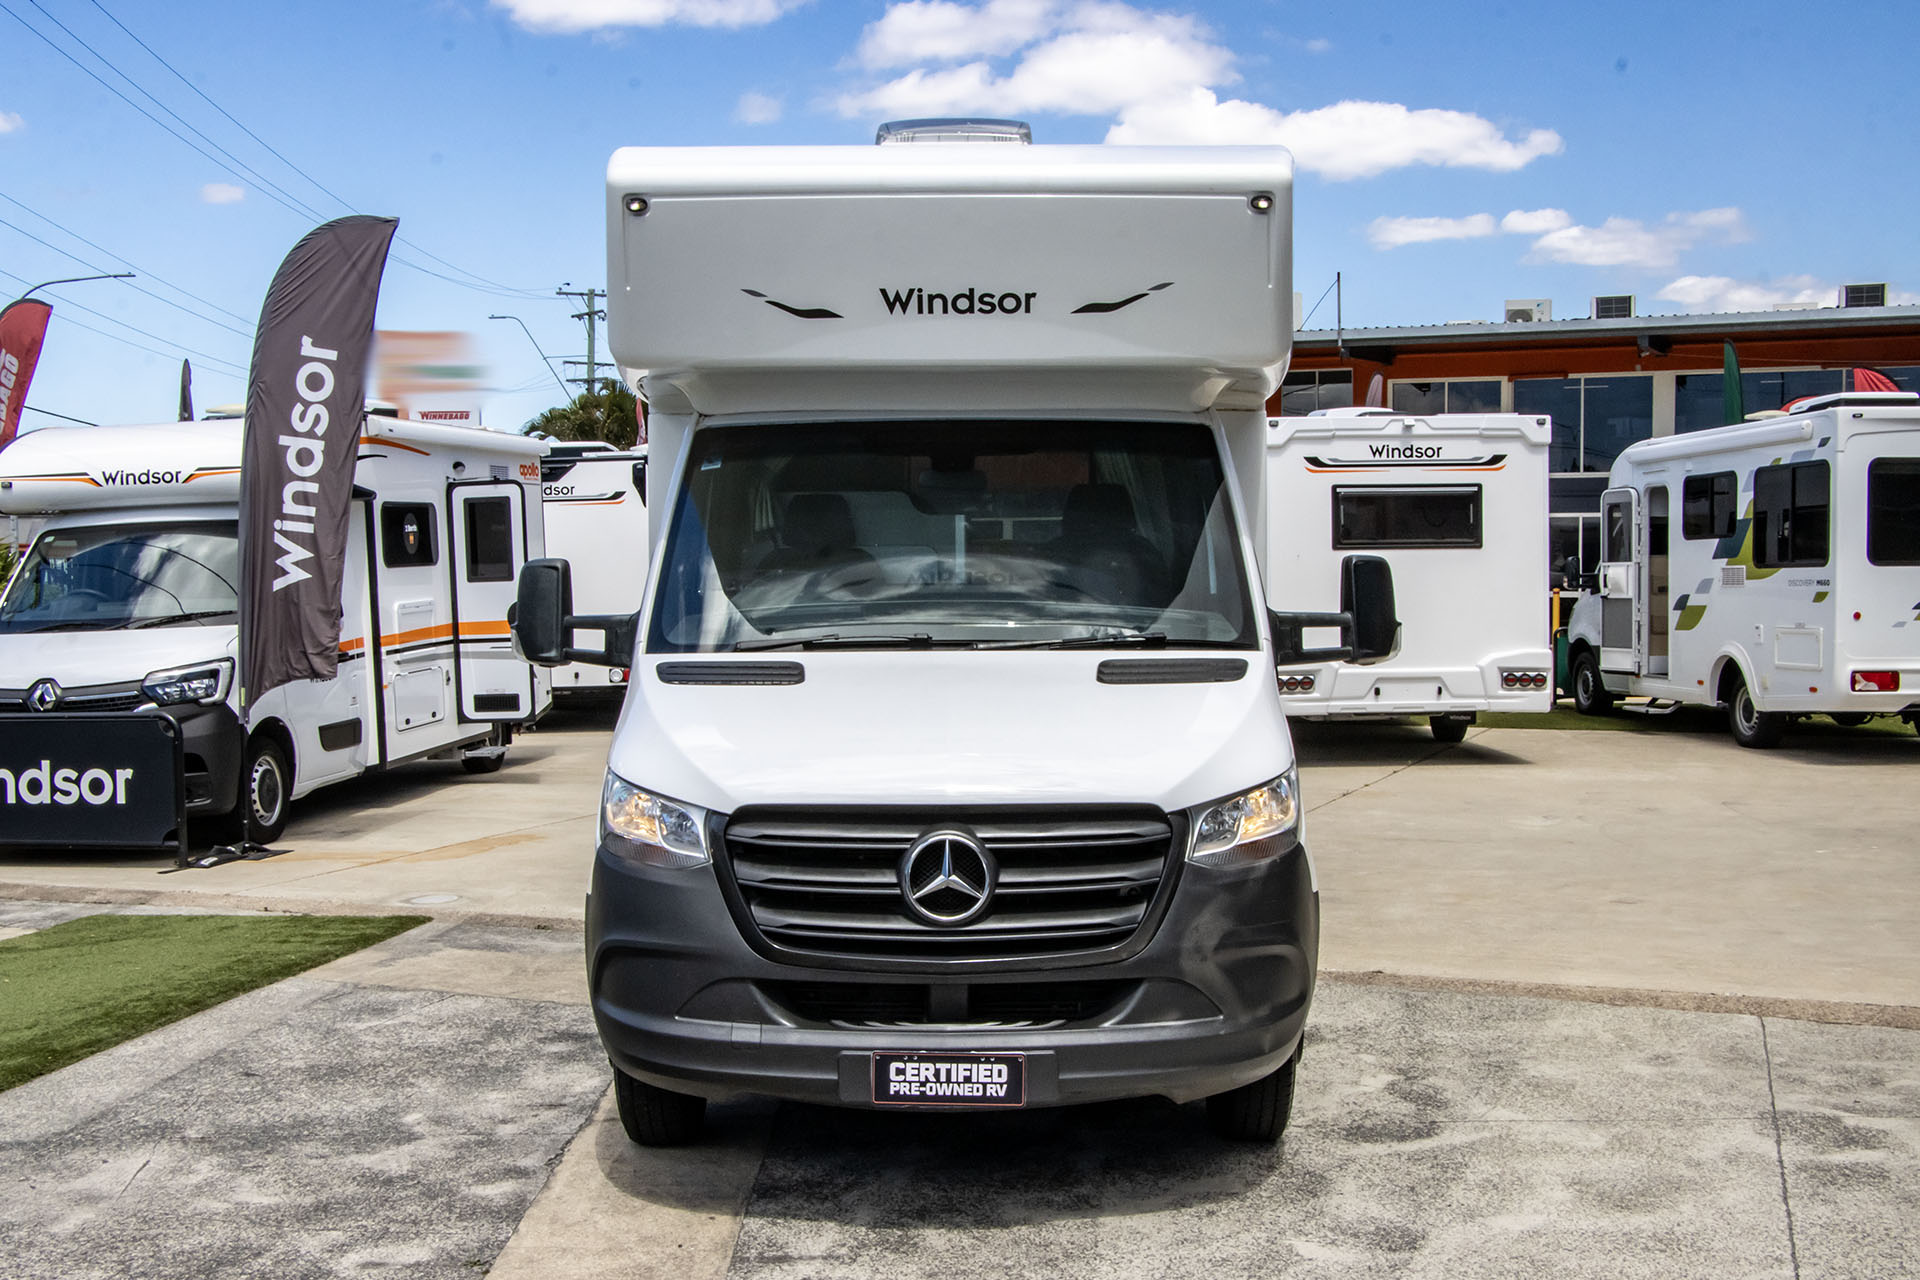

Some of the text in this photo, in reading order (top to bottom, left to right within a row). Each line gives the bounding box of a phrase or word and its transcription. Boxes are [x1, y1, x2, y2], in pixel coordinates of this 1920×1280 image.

[879, 287, 1037, 315] Windsor
[1369, 444, 1442, 458] Windsor
[272, 335, 339, 593] Windsor
[101, 469, 181, 486] Windsor
[889, 1062, 1008, 1083] CERTIFIED
[889, 1082, 1008, 1097] PRE-OWNED RV
